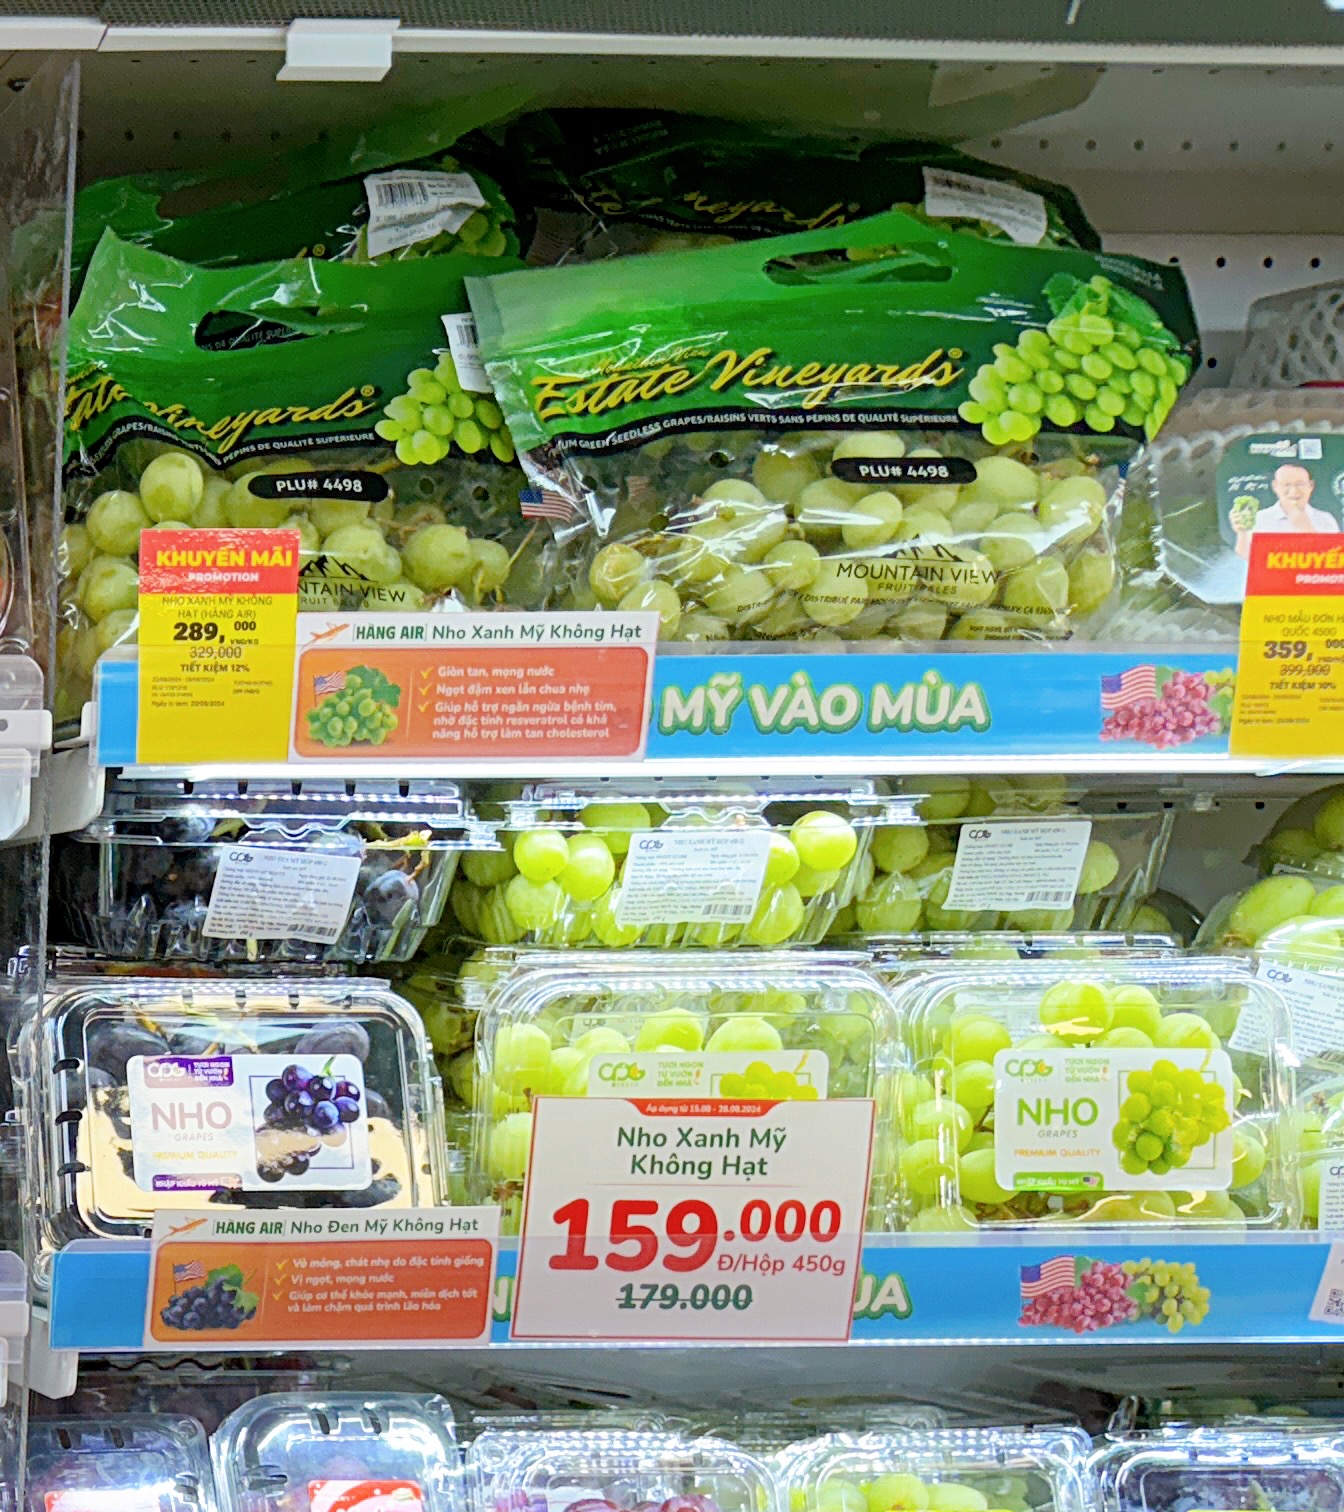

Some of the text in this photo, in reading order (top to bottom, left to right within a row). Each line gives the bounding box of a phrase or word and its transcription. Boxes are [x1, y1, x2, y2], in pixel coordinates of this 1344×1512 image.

[530, 347, 967, 420] Estate Vineyards
[859, 464, 950, 479] PLU# 4498
[275, 478, 363, 494] PLU# 4498
[836, 562, 1002, 585] MOUNTAIN VIEW
[431, 622, 642, 643] Nho Xanh Mỹ Không Hạt
[662, 670, 987, 729] MỸ VÀO MÙA
[150, 1100, 233, 1132] NHO
[1017, 1096, 1099, 1127] NHO
[616, 1126, 787, 1153] Nho Xanh Mỹ
[630, 1153, 768, 1182] Không Hạt
[290, 1216, 479, 1237] Nho Đen Mỹ Không Hạt
[547, 1198, 842, 1273] 159.000
[716, 1253, 846, 1277] Đ/Hộp 450g
[615, 1282, 754, 1312] 179.000
